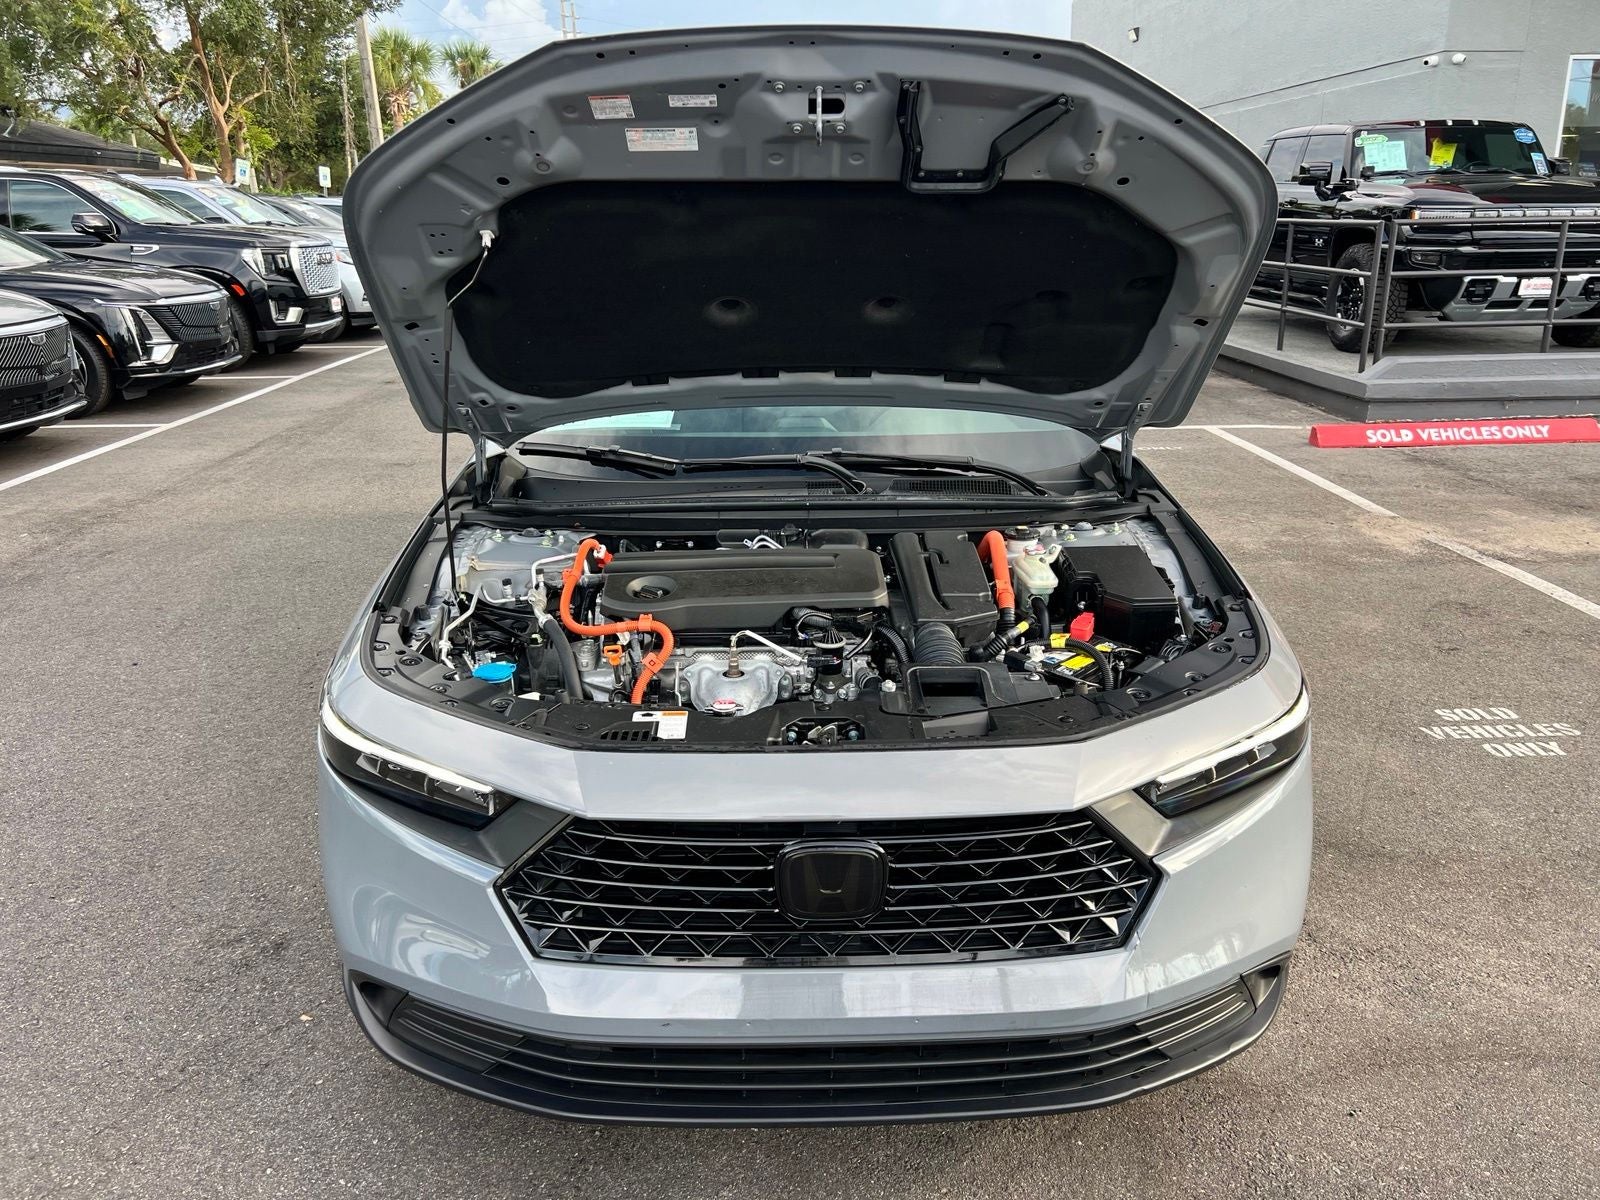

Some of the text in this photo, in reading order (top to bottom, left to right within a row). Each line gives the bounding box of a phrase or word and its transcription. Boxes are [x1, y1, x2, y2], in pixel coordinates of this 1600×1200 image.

[1365, 424, 1550, 443] SOLD VEHICLES ONLY
[1434, 707, 1519, 721] SOLD
[1418, 722, 1581, 739] VEHICLES
[1482, 741, 1568, 758] ONLY
